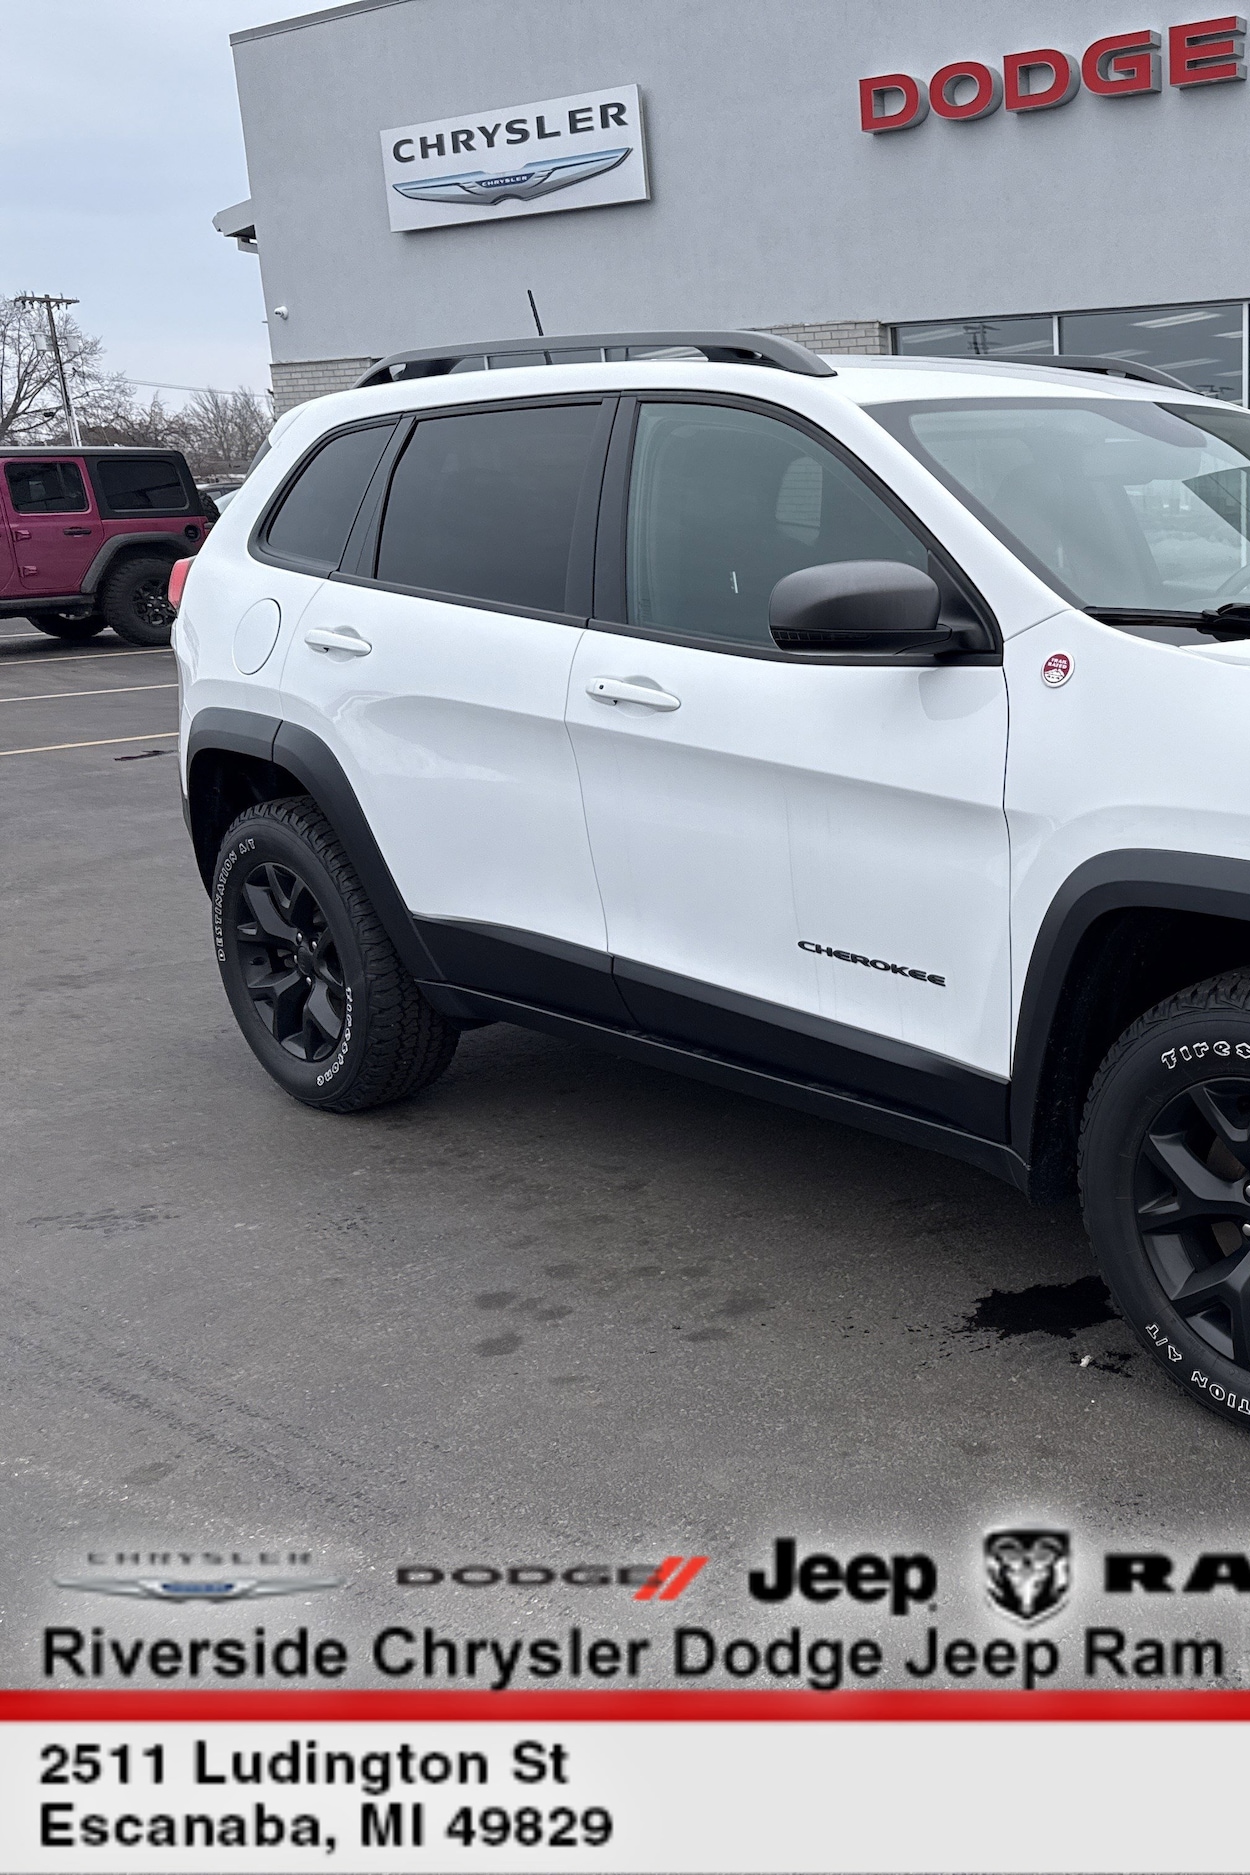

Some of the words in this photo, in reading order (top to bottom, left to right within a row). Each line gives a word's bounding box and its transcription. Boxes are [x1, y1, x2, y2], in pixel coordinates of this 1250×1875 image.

[859, 16, 1246, 134] DODGE
[392, 102, 629, 163] CHRYSLER
[481, 175, 528, 187] CHRYSLER
[214, 849, 238, 962] DESTINATION
[797, 940, 947, 987] CHEROKEE
[1145, 1323, 1183, 1363] A/T
